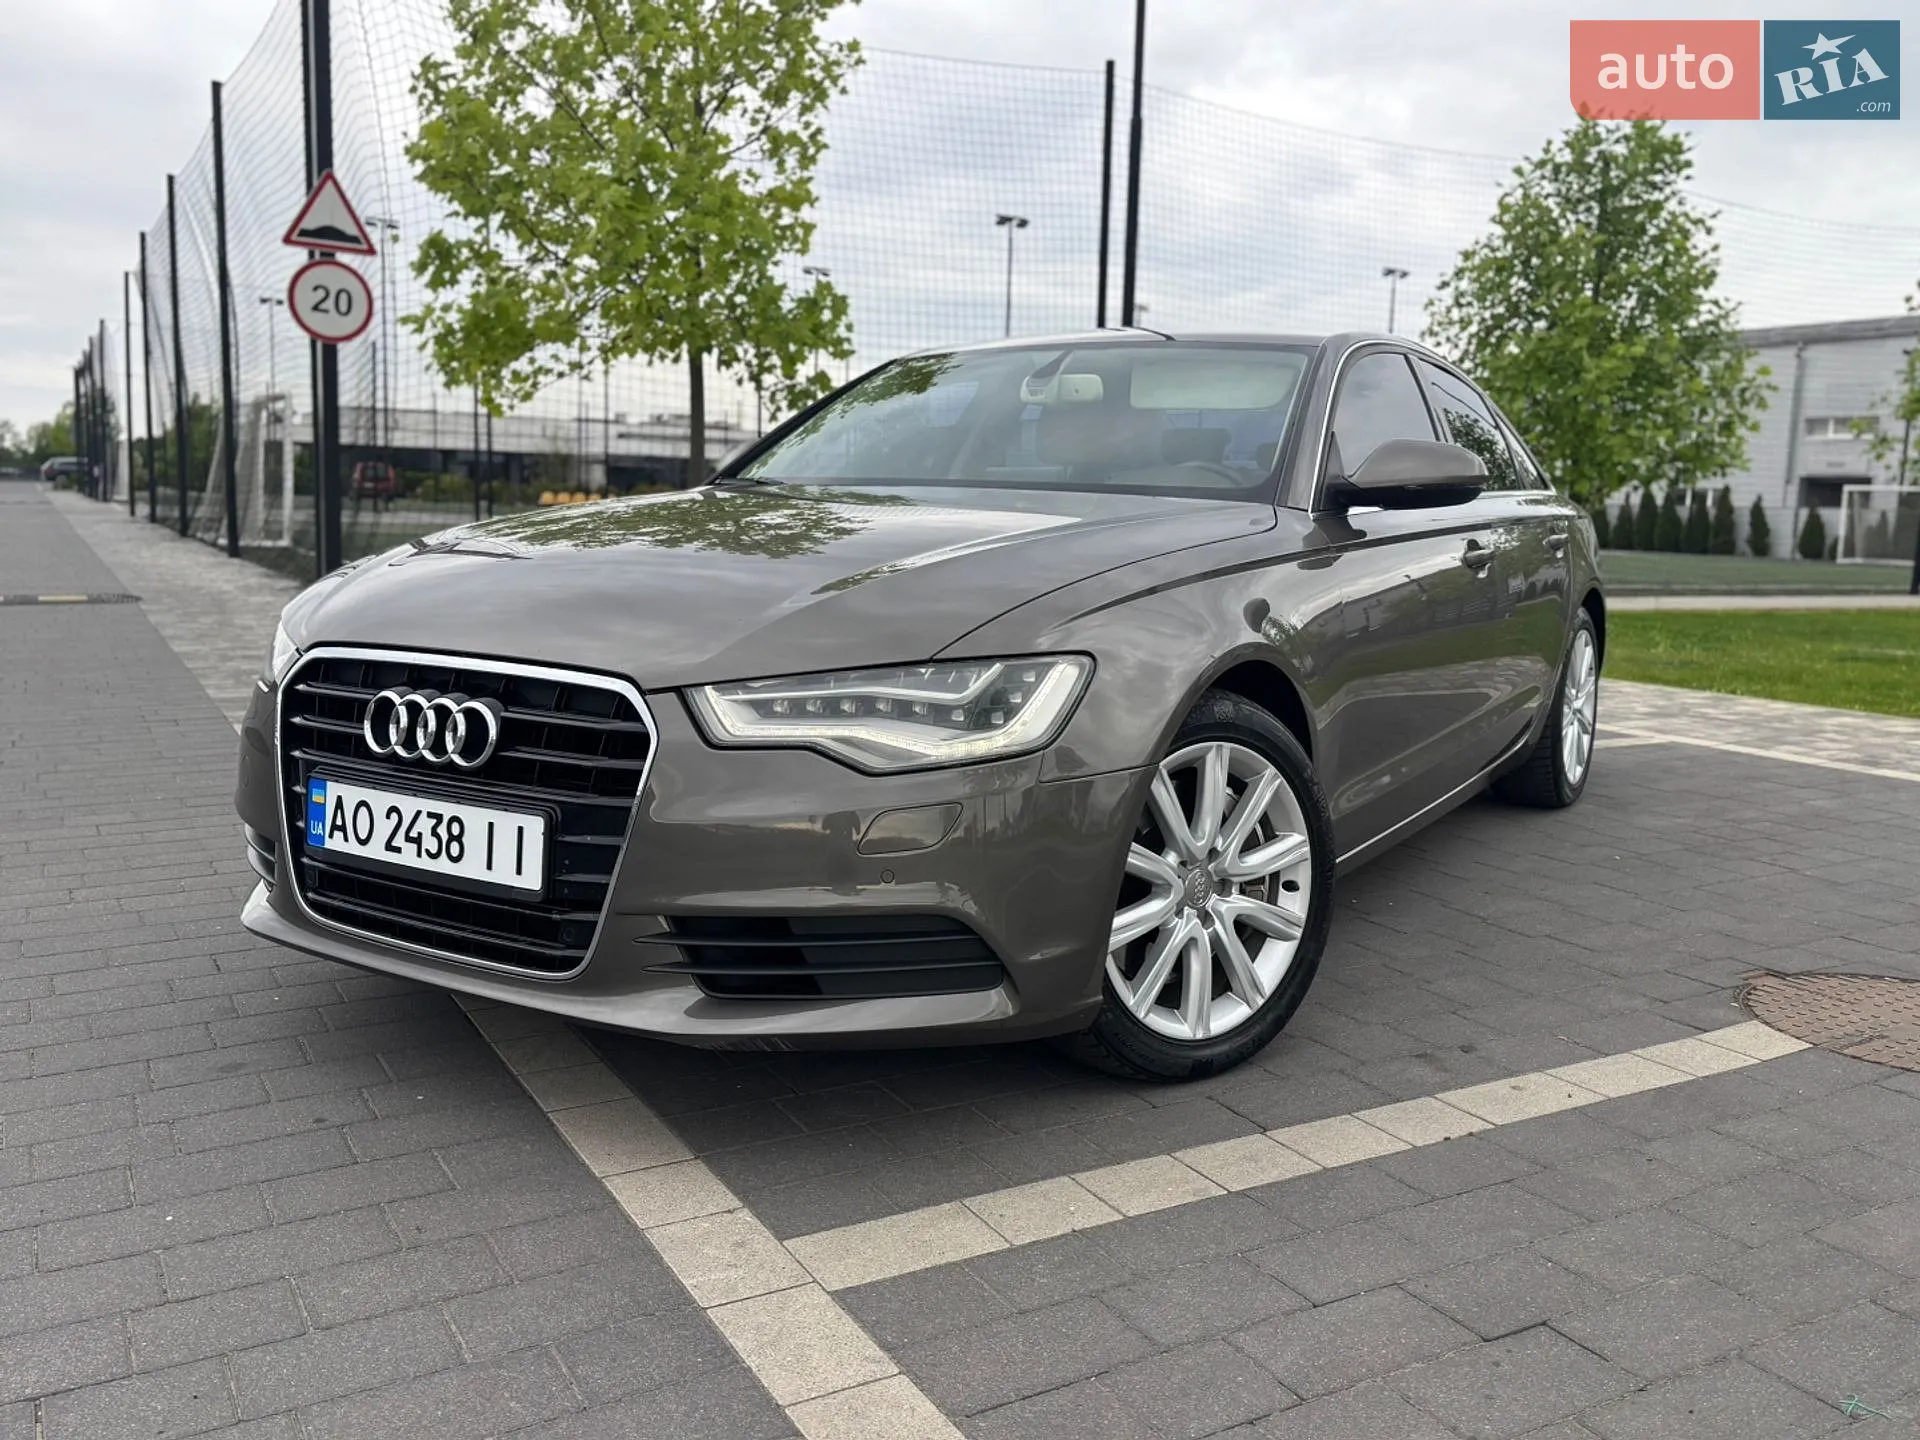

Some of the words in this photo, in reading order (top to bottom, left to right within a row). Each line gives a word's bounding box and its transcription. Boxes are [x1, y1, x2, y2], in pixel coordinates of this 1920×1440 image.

[310, 284, 353, 316] 20
[310, 820, 324, 836] UA
[328, 795, 375, 846] AO
[384, 805, 465, 863] 2438
